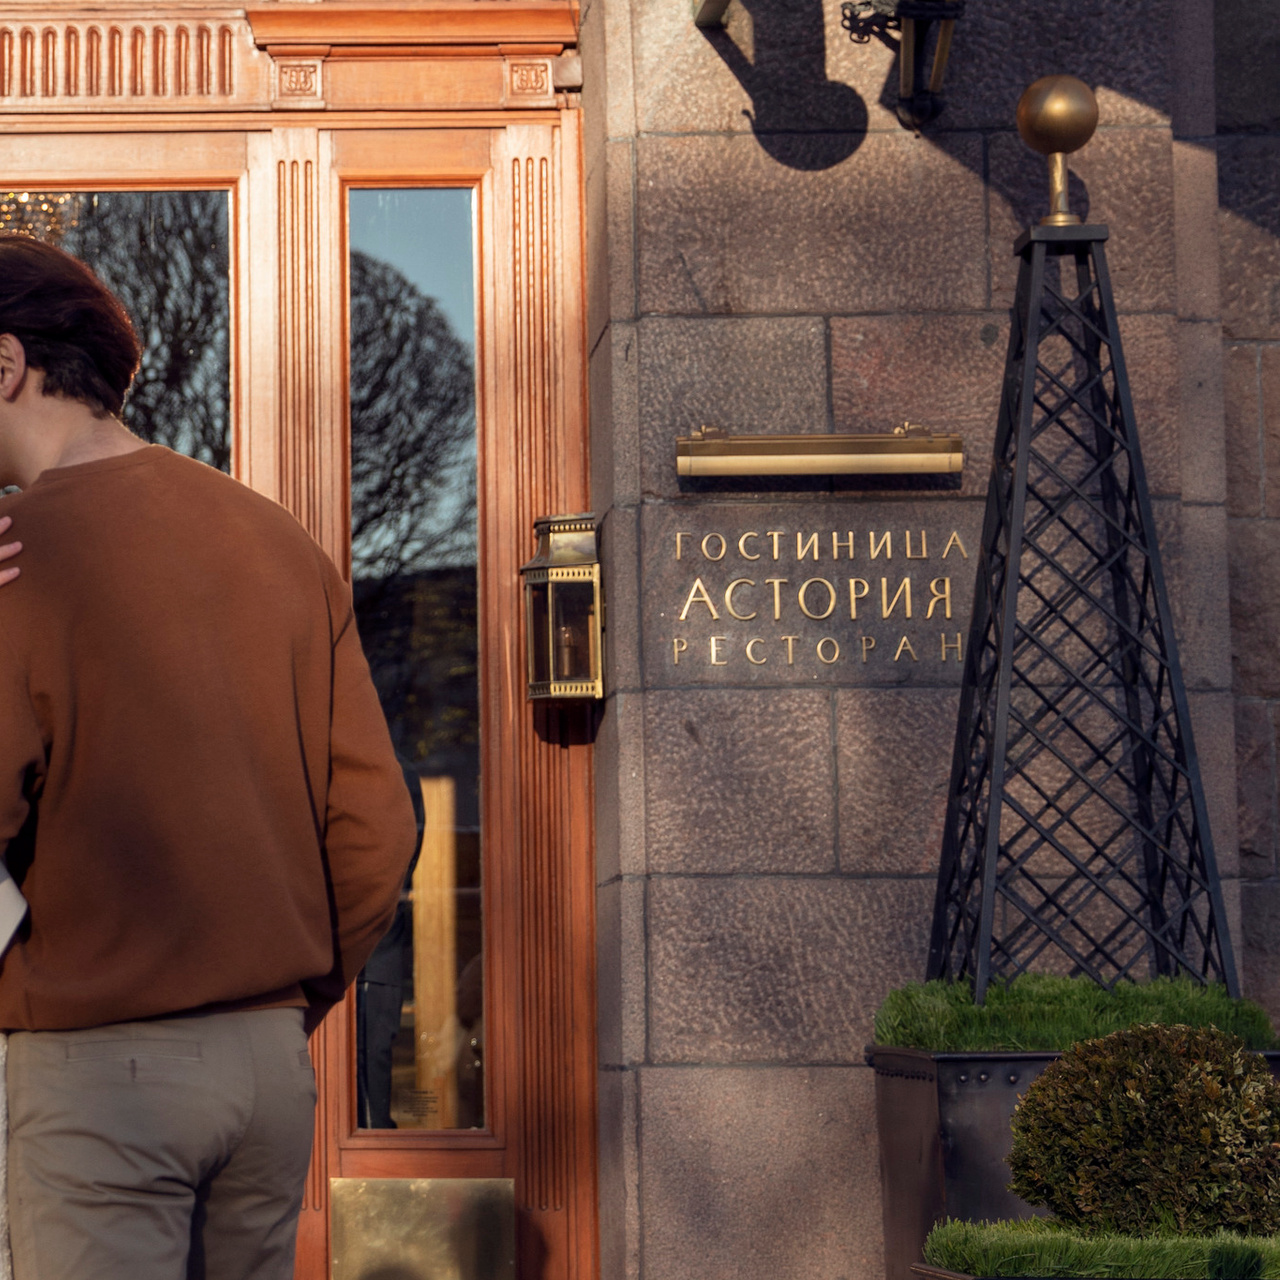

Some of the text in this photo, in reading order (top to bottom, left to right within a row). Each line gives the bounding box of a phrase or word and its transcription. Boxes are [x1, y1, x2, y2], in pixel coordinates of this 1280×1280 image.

[675, 530, 969, 561] ГОСТИНИЦА
[679, 577, 952, 620] АСТОРИЯ
[673, 632, 963, 666] РЕСТОРАН
